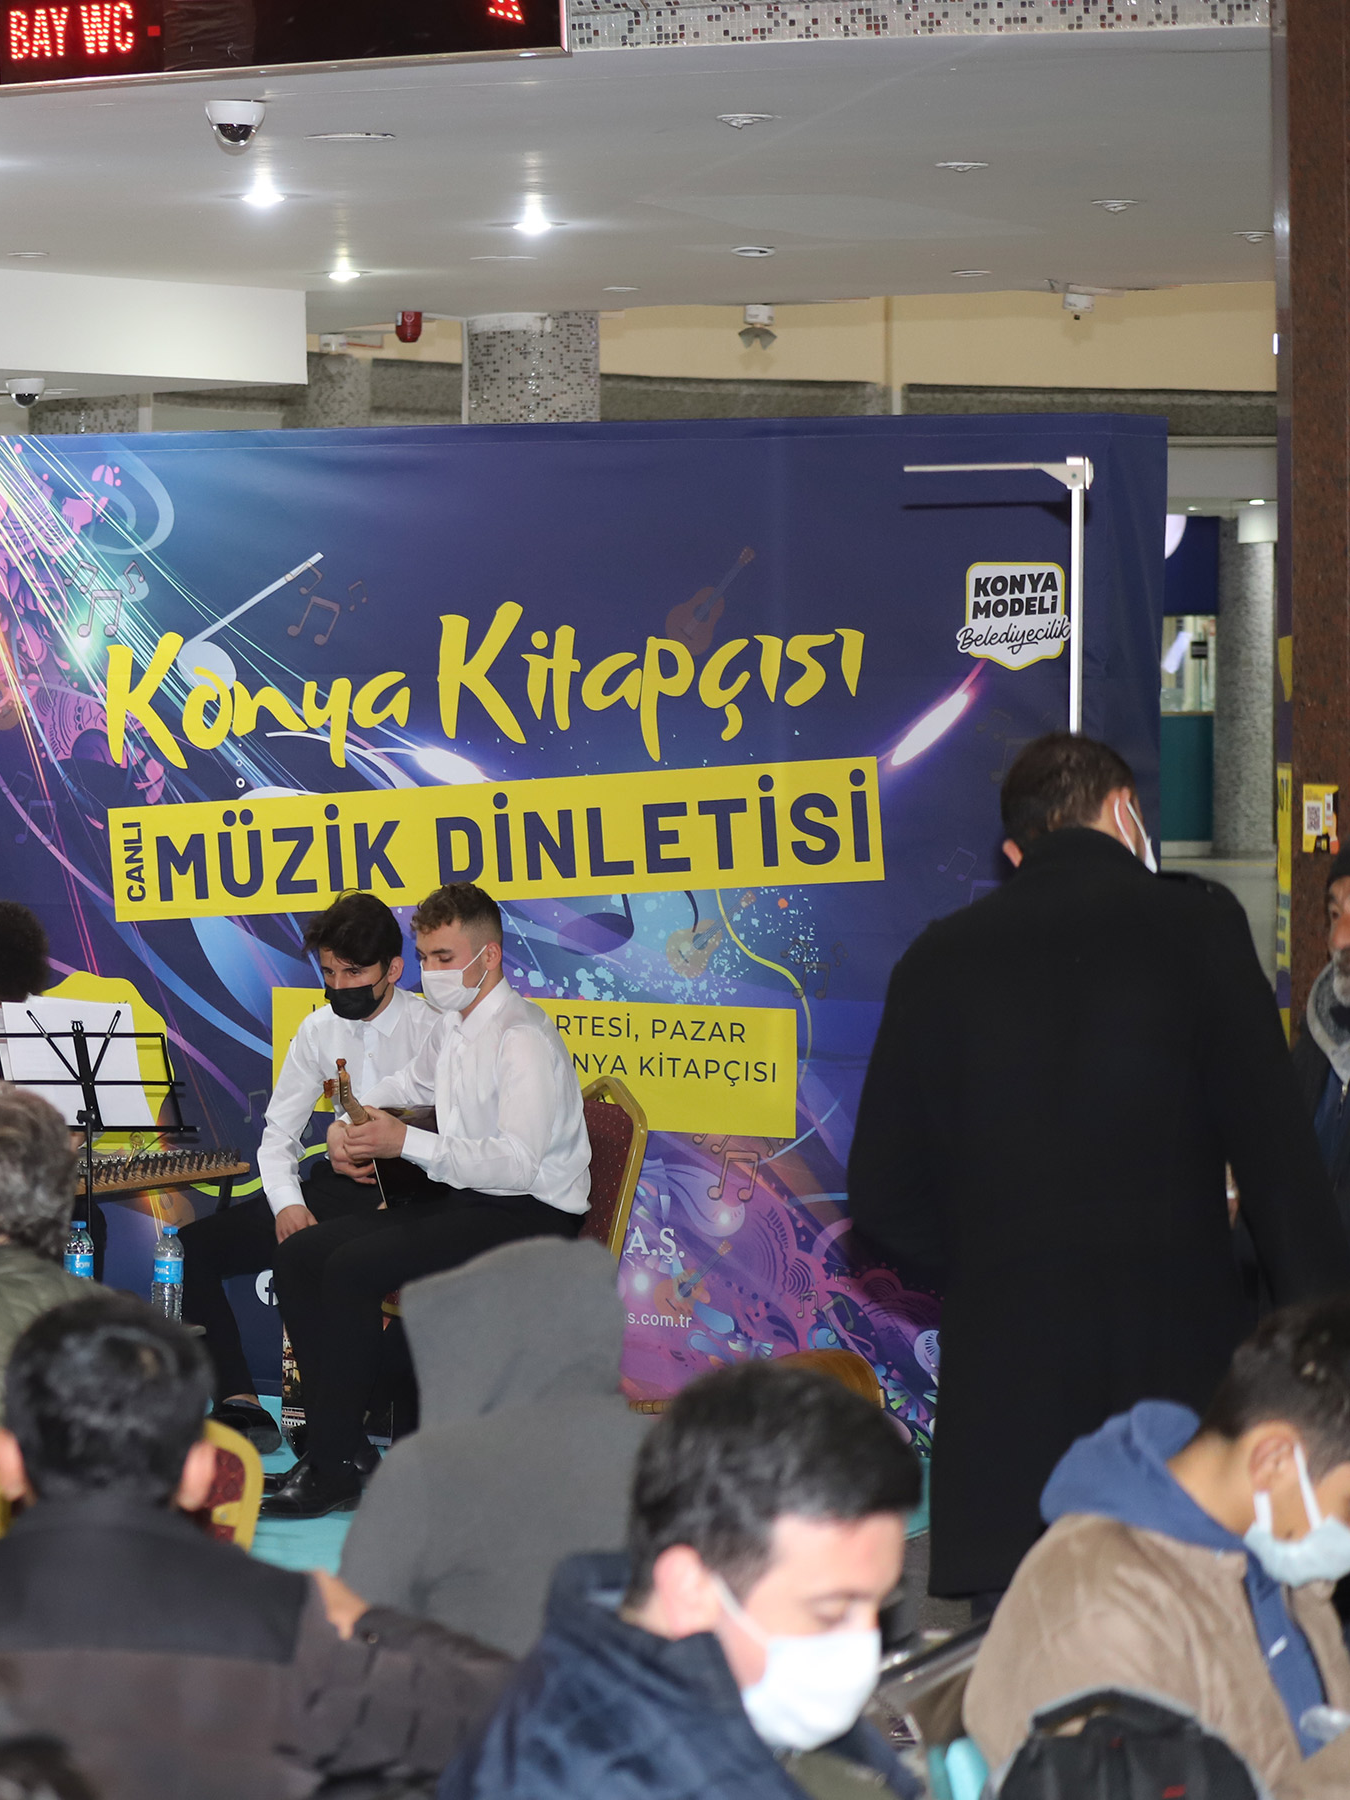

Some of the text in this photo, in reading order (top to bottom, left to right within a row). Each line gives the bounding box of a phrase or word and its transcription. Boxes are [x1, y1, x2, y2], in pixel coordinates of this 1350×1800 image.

[9, 1, 135, 60] BAY WC
[973, 571, 1059, 598] KONYA
[971, 594, 1059, 620] MODELİ
[958, 617, 1071, 655] Belediyecilik
[106, 631, 411, 769] Konya
[437, 600, 865, 762] Kitapçısı
[155, 768, 871, 902] MÜZİK DİNLETİSİ
[121, 821, 147, 903] CANLI
[651, 1018, 747, 1044] PAZAR
[639, 1051, 777, 1087] KİTAPÇISI
[625, 1226, 686, 1264] A.Ş.
[627, 1312, 693, 1329] s.com.tr
